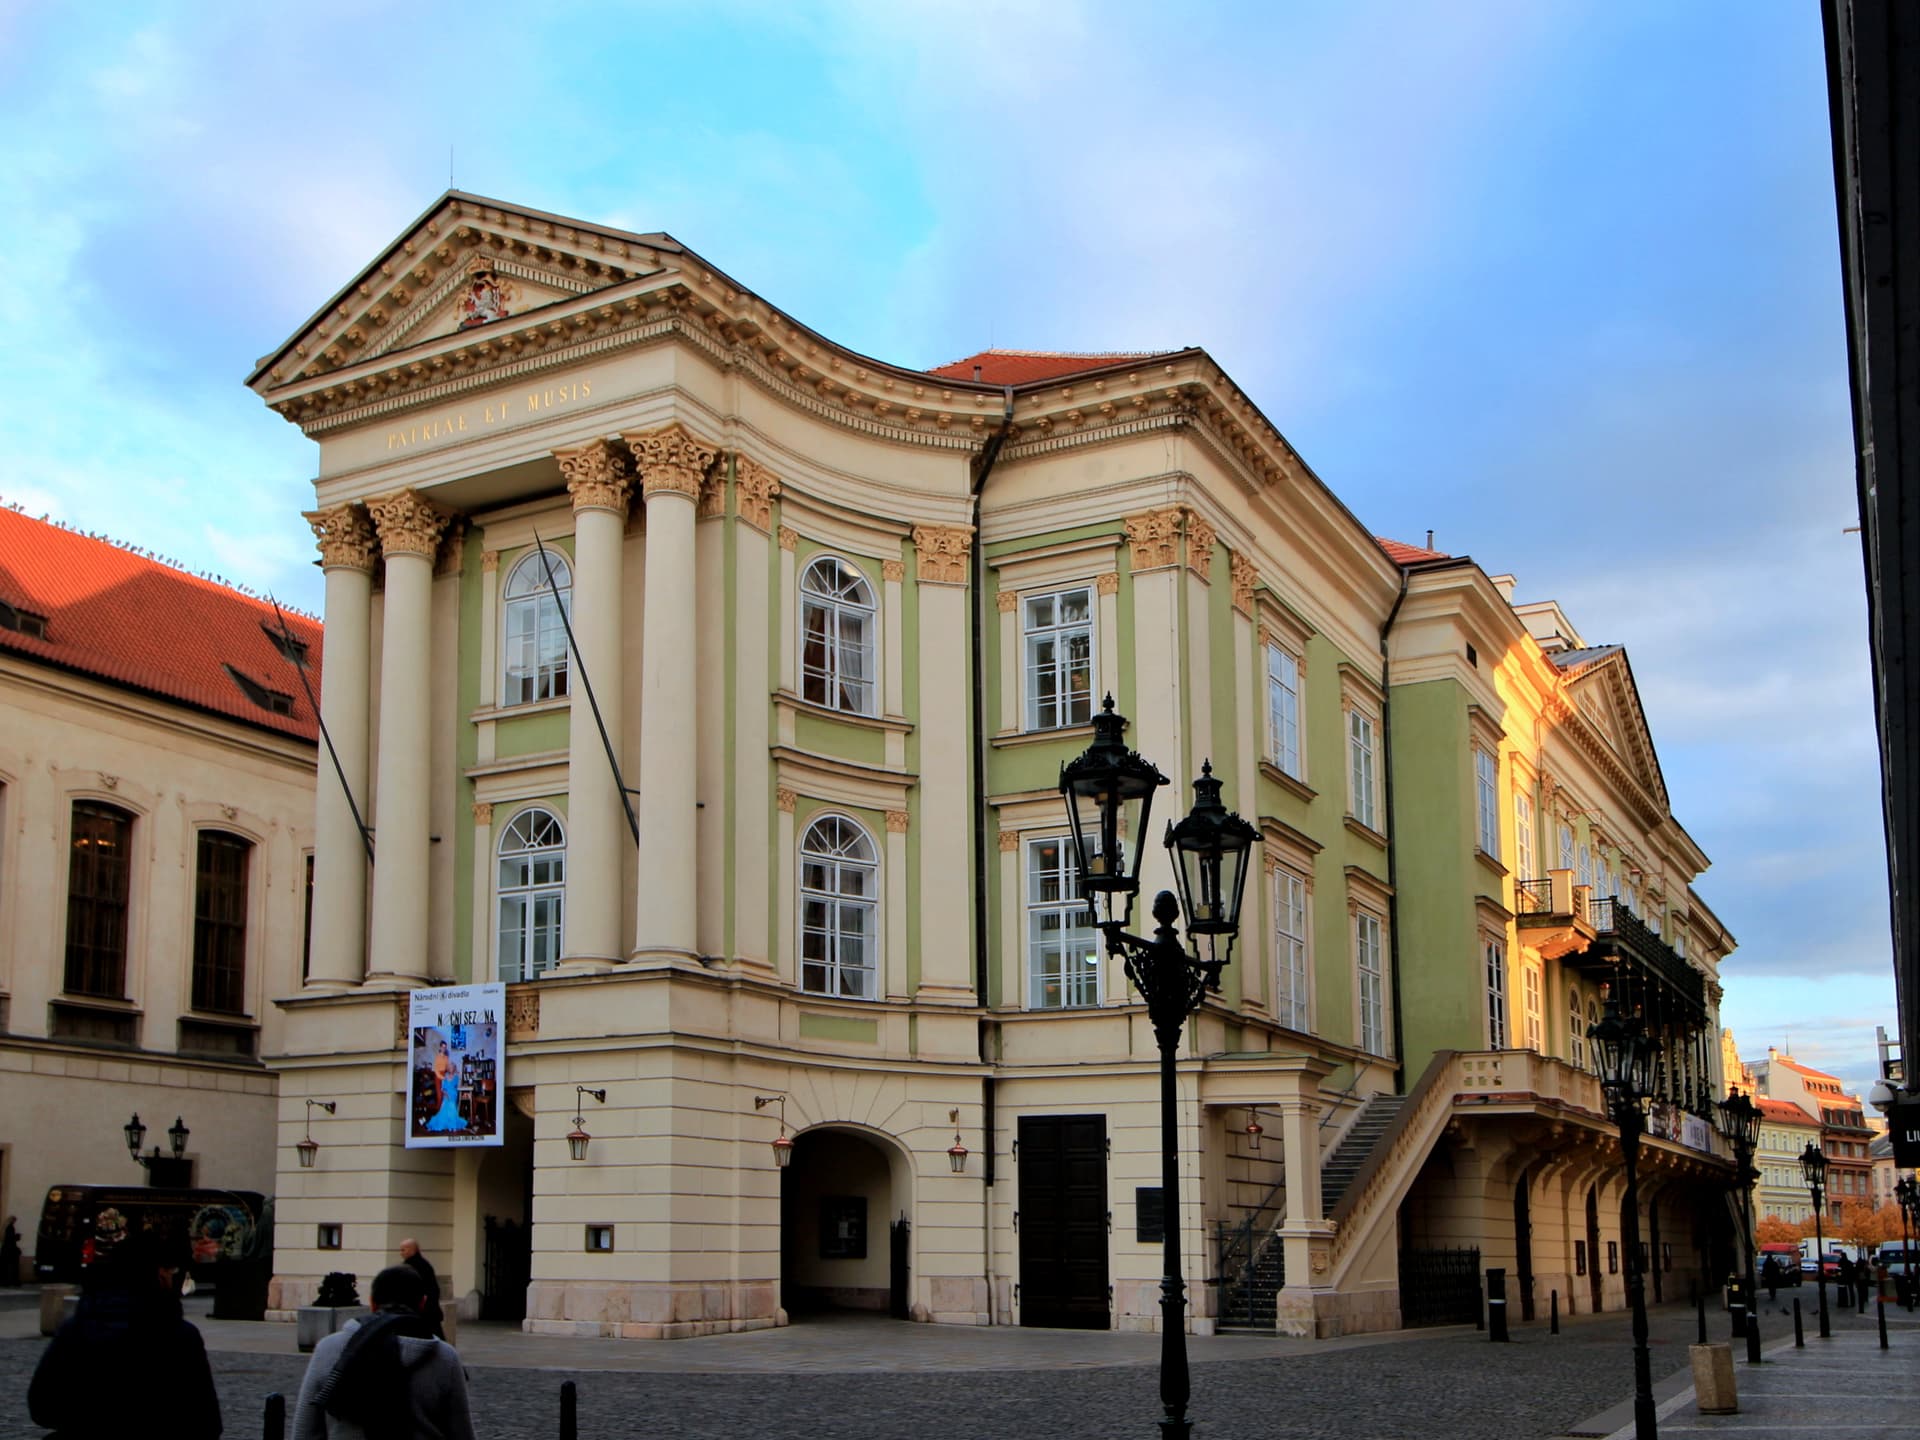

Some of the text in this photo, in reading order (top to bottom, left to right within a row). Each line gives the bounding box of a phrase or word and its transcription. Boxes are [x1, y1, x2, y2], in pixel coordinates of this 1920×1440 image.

[387, 381, 592, 448] PATRIAE ET MUSIS
[414, 991, 469, 1001] Národní divadlo
